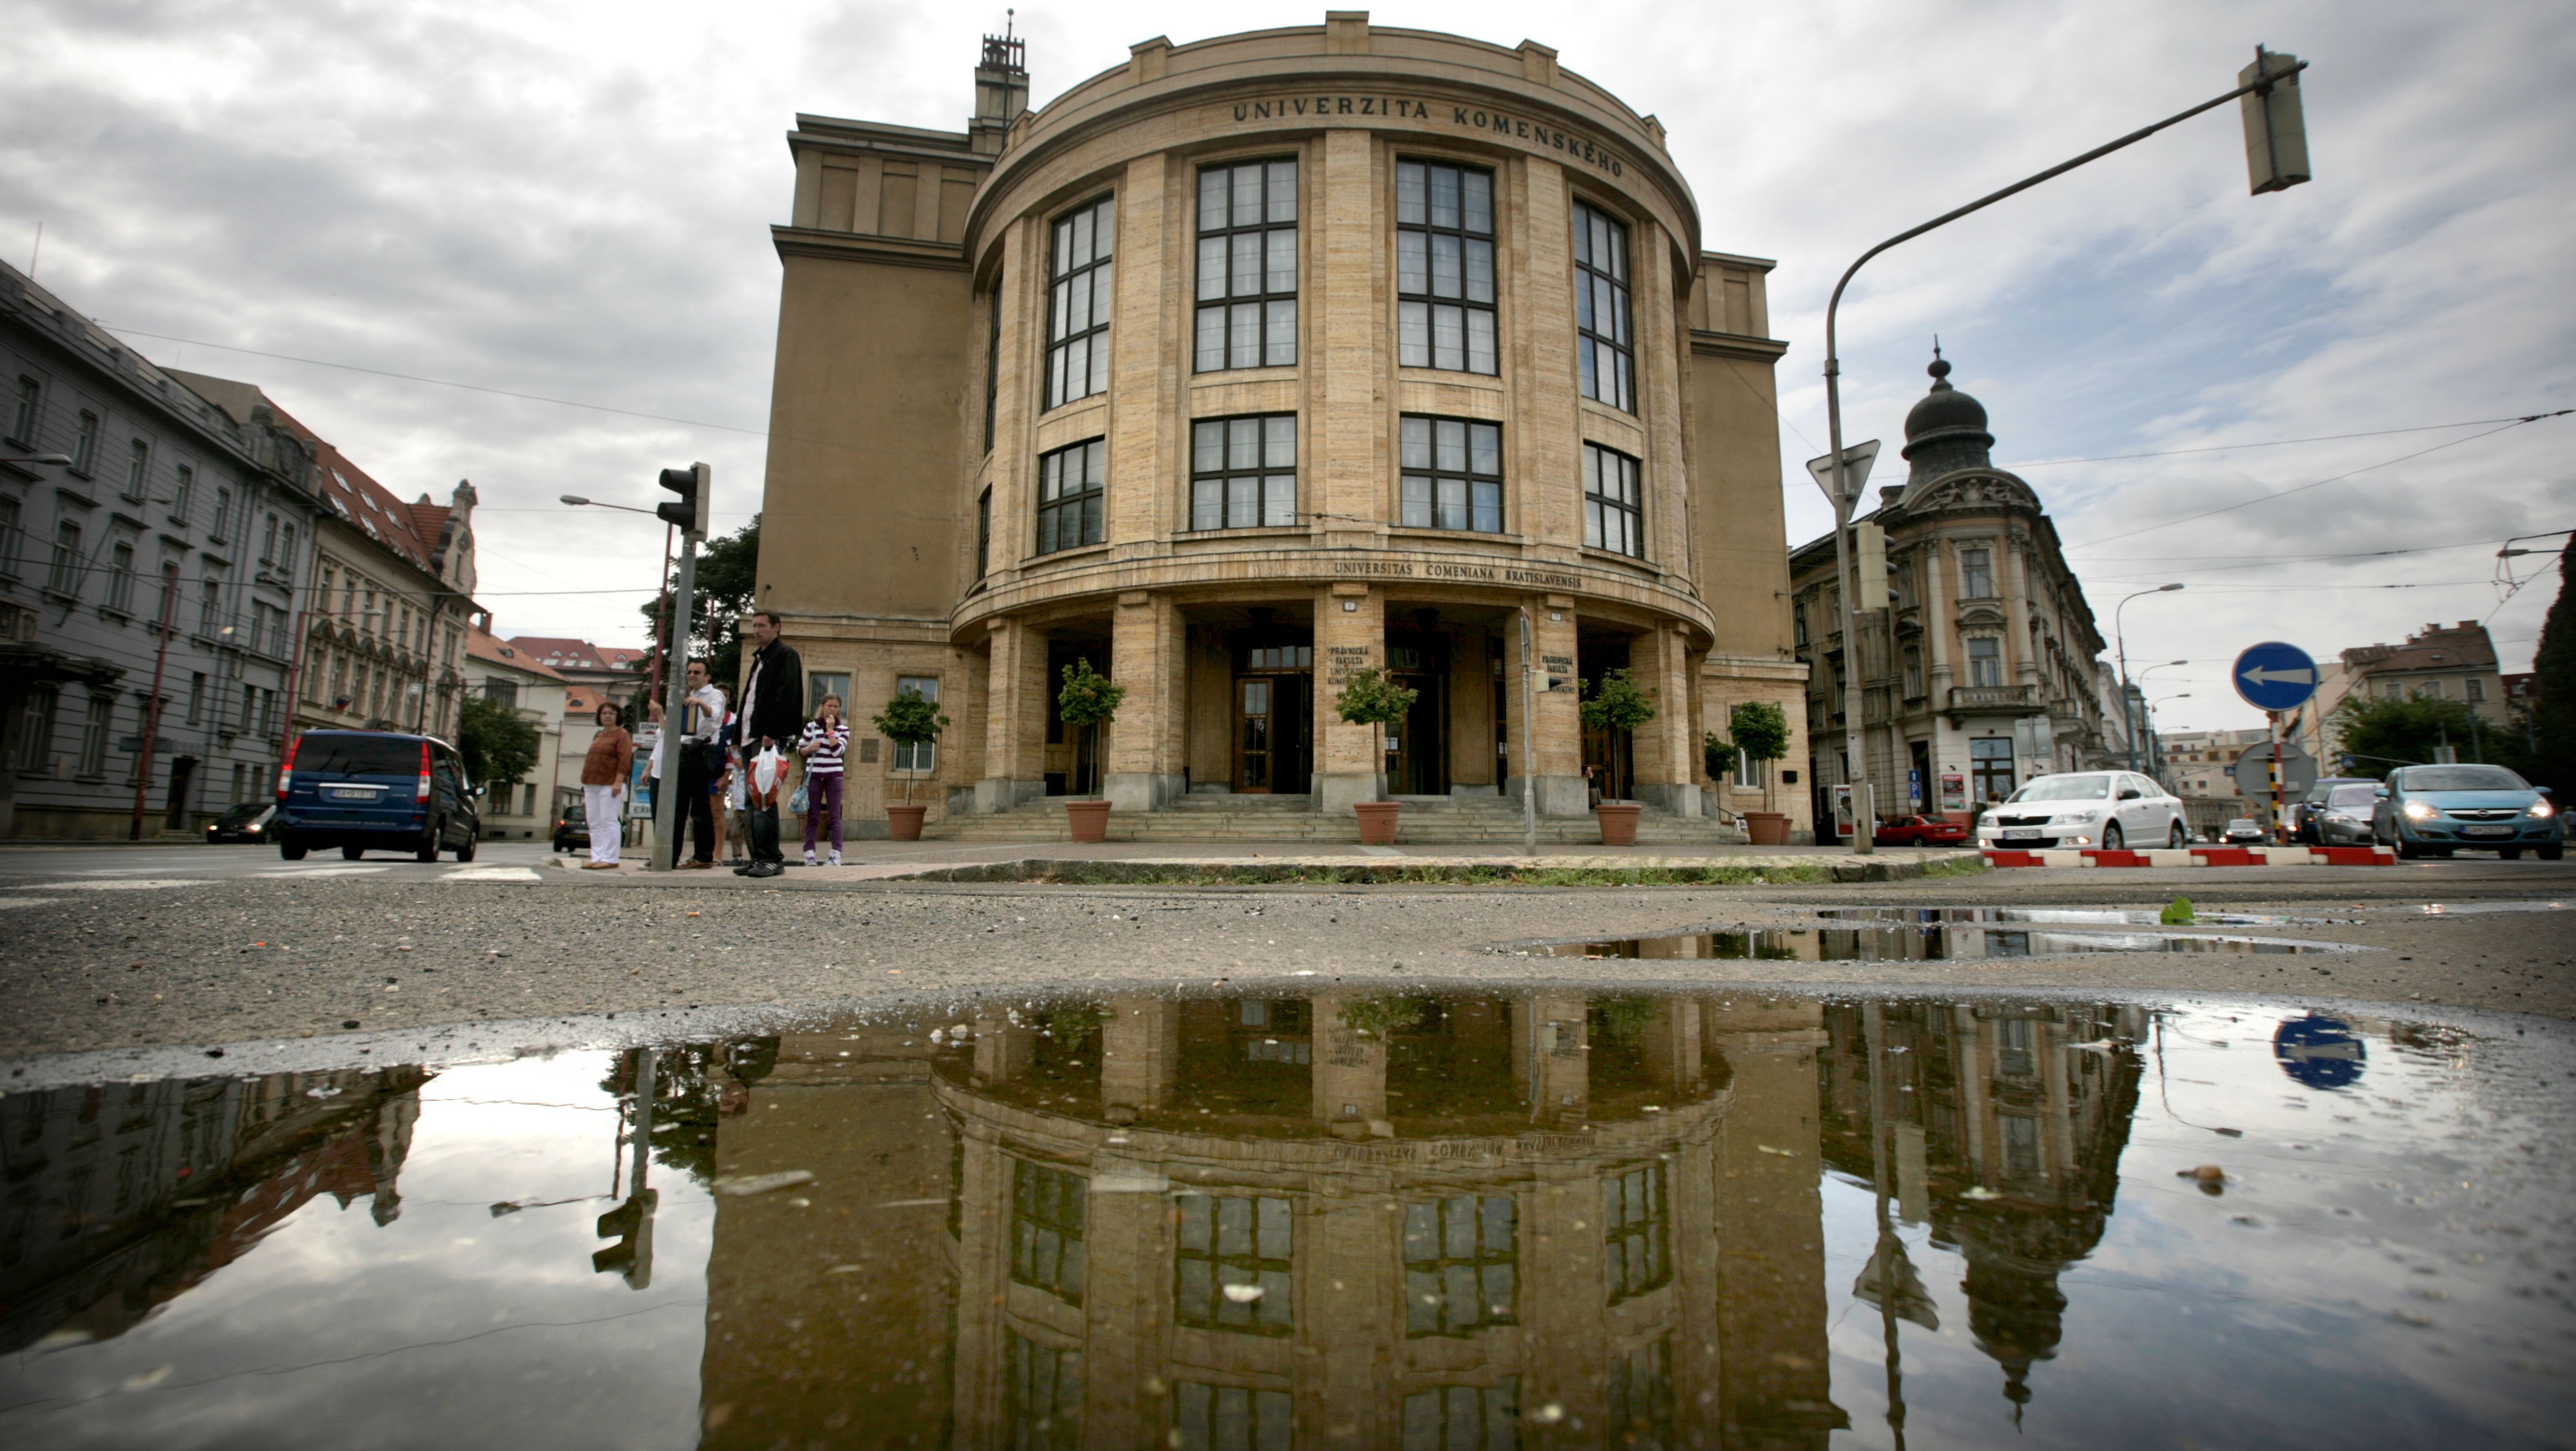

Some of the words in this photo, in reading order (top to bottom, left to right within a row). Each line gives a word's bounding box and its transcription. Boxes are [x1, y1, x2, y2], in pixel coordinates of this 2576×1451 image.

[1234, 97, 1428, 121] UNIVERZITA
[1454, 107, 1622, 177] KOMENSKÉHO
[1334, 562, 1413, 575] UNIVERSITAS
[1426, 565, 1495, 579] COMENIANA
[1506, 570, 1581, 589] BRATISLAVENSIS
[1331, 645, 1368, 655] PRÁVNICKÁ
[1336, 656, 1363, 665] FAKULTA
